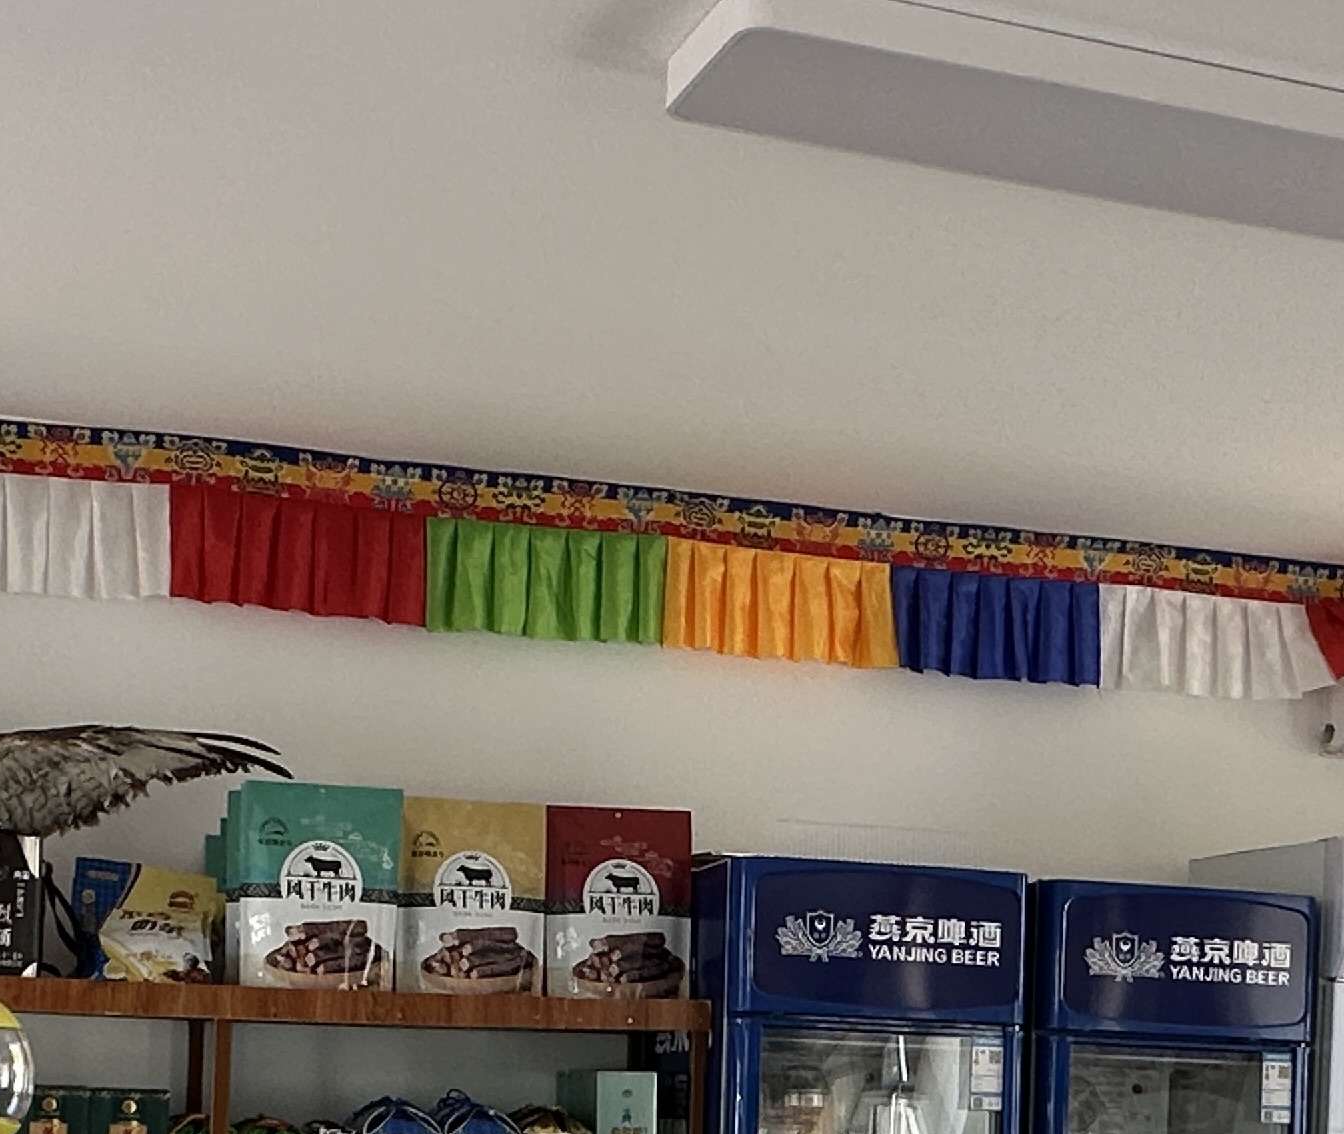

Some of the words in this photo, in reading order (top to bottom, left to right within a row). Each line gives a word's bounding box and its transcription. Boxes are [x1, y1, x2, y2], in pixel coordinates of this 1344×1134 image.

[287, 879, 356, 903] 风干牛肉
[440, 888, 506, 910] 风干牛肉
[589, 894, 654, 916] 风干牛肉
[868, 913, 1002, 948] 燕京啤酒
[869, 943, 947, 964] YANJING
[951, 950, 1001, 967] BEER
[1170, 936, 1292, 969] 燕京啤酒
[1170, 963, 1243, 984] YANJING
[1245, 968, 1290, 987] BEER
